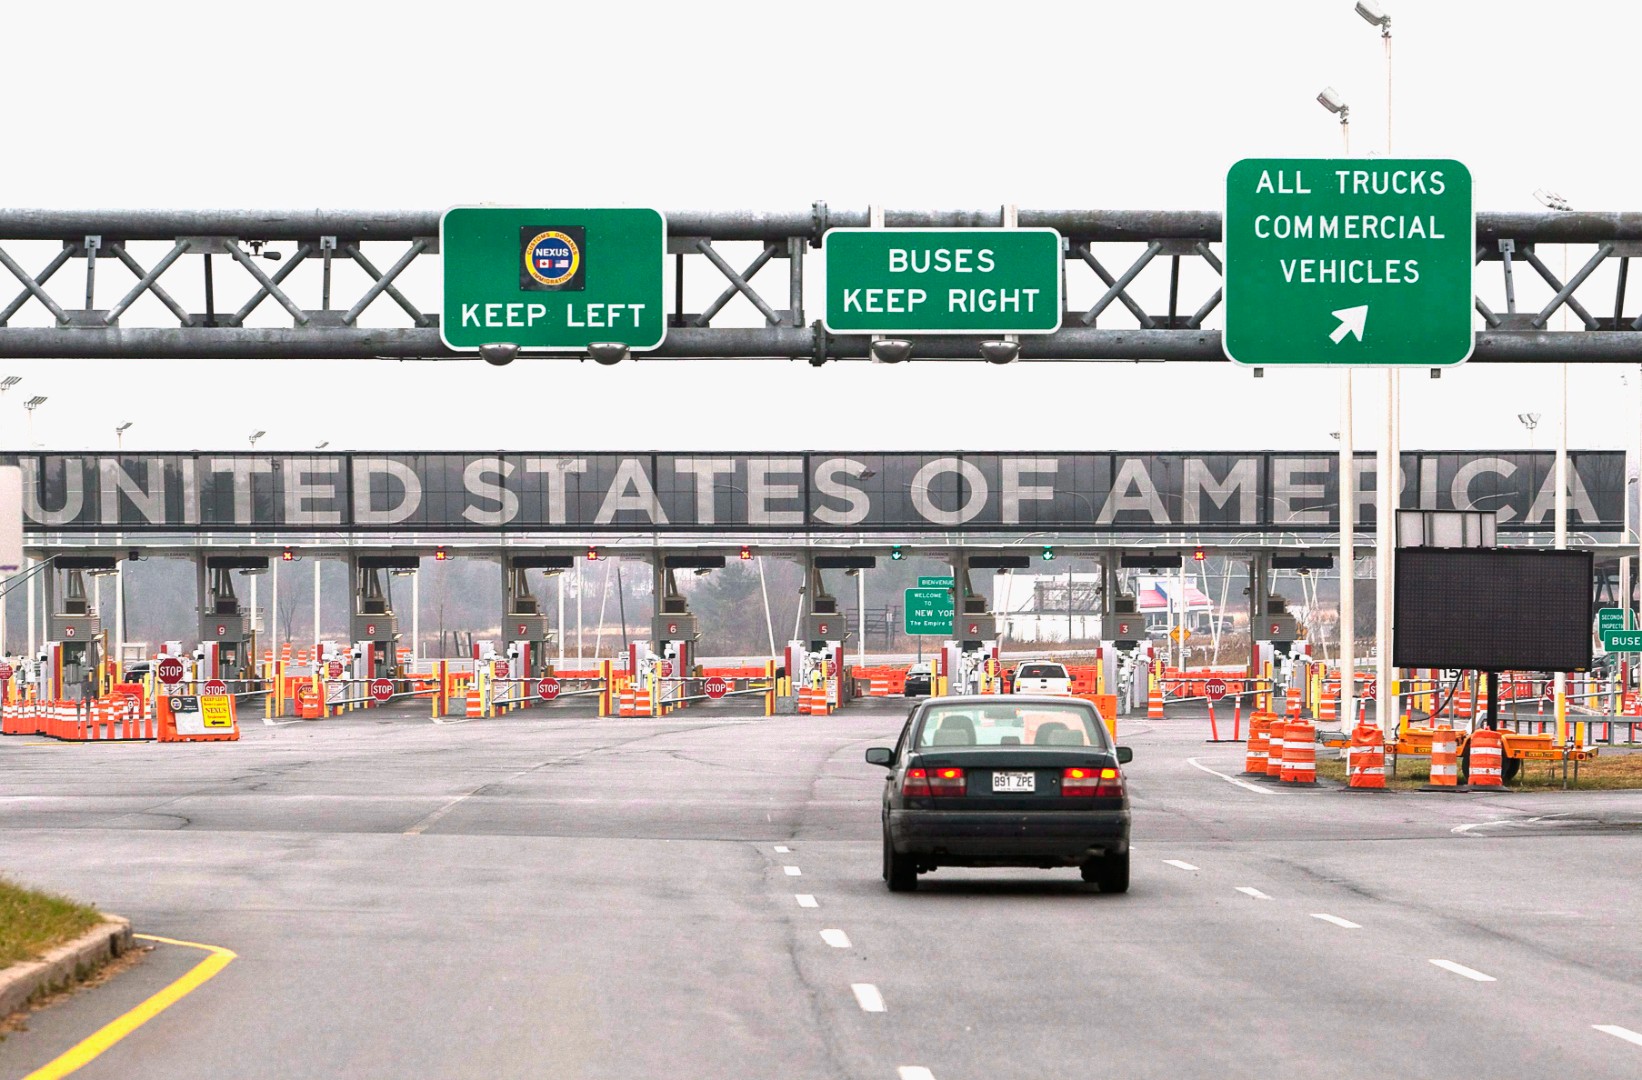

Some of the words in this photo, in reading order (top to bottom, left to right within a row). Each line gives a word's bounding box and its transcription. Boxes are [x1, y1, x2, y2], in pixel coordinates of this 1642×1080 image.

[1256, 170, 1311, 194] ALL
[1335, 170, 1445, 195] TRUCKS
[1254, 215, 1445, 239] COMMERCIAL
[527, 232, 550, 255] CUSTOMS
[535, 248, 569, 257] NEXUS
[888, 248, 995, 274] BUSES
[1280, 259, 1419, 284] VEHICLES
[843, 288, 928, 313] KEEP
[948, 288, 1040, 313] RIGHT
[461, 303, 547, 328] KEEP
[567, 303, 646, 328] LEFT
[17, 458, 422, 526] UNITED
[461, 458, 870, 526] STATES
[910, 458, 1059, 526] OF
[66, 628, 75, 636] 10
[218, 627, 226, 636] 9
[368, 626, 375, 634] 8
[520, 626, 527, 634] 7
[670, 626, 676, 634] 6
[821, 626, 828, 634] 5
[970, 626, 978, 634] 4
[1612, 636, 1640, 646] BUSE
[160, 666, 182, 676] STOP
[206, 686, 225, 695] STOP
[373, 685, 392, 694] STOP
[539, 684, 558, 693] STOP
[706, 684, 726, 693] STOP
[1206, 685, 1226, 694] STOP
[994, 776, 1010, 787] 891
[1016, 776, 1033, 787] ZPE
